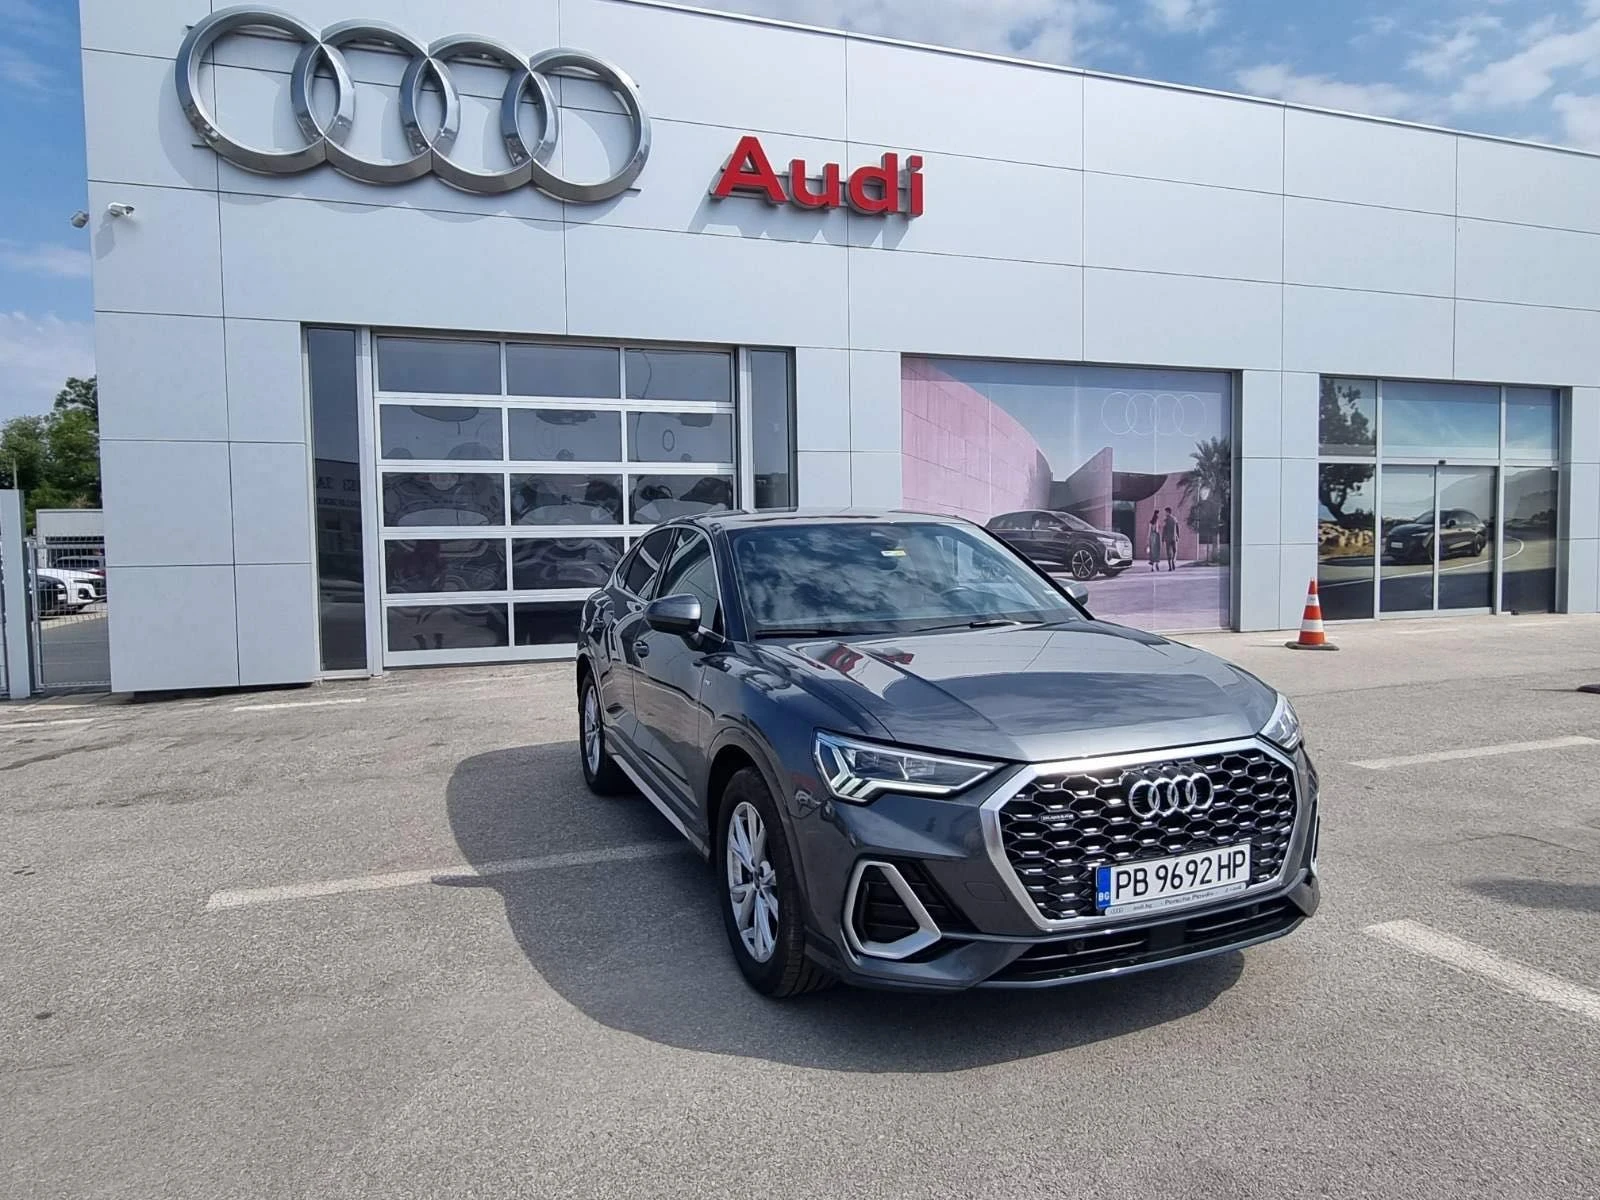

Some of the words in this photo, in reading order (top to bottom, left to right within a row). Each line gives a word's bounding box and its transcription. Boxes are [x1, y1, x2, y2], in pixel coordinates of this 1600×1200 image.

[711, 135, 924, 217] Audi
[1098, 891, 1110, 902] BG
[1115, 867, 1149, 900] PB
[1155, 856, 1213, 893] 9692
[1217, 849, 1246, 882] HP
